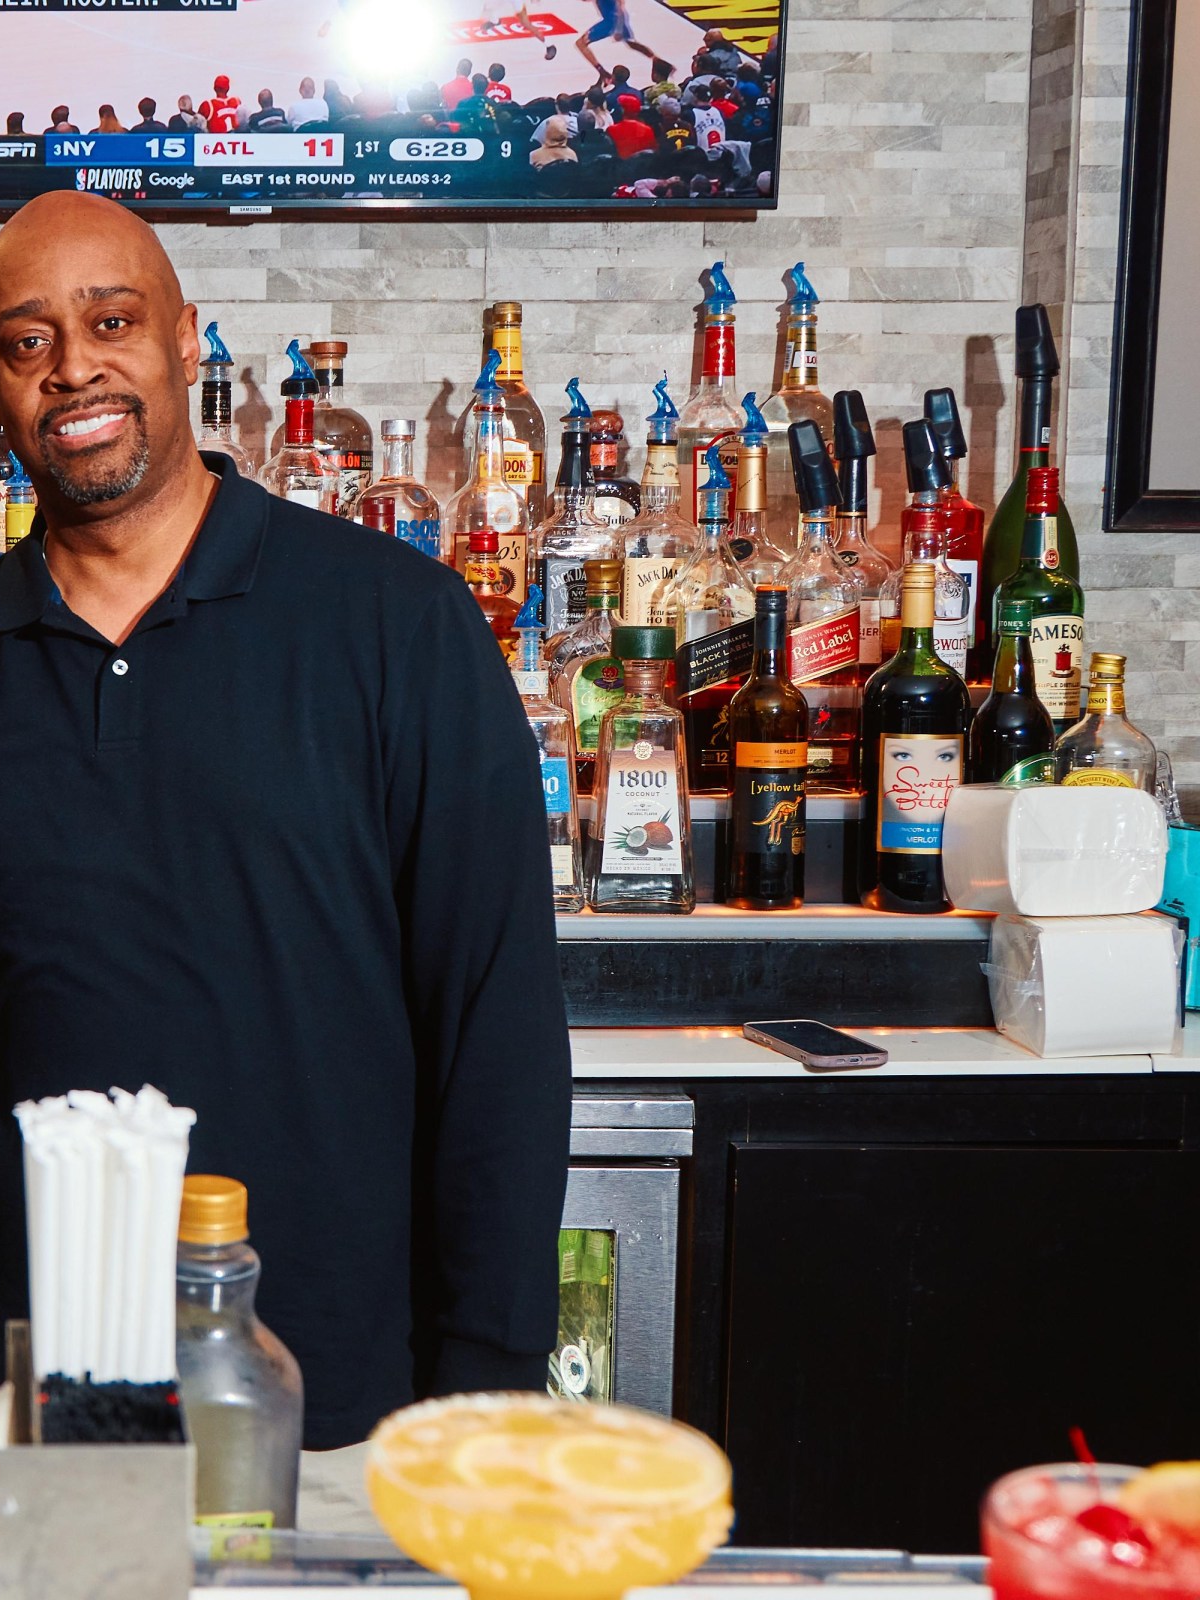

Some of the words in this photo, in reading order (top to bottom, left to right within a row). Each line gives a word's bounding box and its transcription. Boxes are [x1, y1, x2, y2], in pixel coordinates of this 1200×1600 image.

[145, 138, 186, 158] 15
[303, 138, 333, 157] 11
[406, 142, 468, 157] 6:28
[500, 141, 512, 158] 9
[87, 169, 143, 190] PLAYOFFS
[149, 173, 195, 188] Google
[222, 174, 262, 185] EAST
[268, 174, 290, 185] 1st
[296, 174, 355, 185] ROUND
[368, 174, 384, 185] NY
[389, 174, 429, 185] LEADS
[432, 174, 451, 185] 3-2
[550, 570, 574, 589] JACK
[575, 566, 587, 581] DA
[637, 569, 661, 588] JACK
[1031, 624, 1083, 643] AMESO
[792, 642, 819, 660] Red
[820, 629, 854, 651] Label
[689, 651, 721, 669] BLACK
[723, 641, 753, 656] LABEL
[716, 752, 728, 763] 12
[774, 748, 796, 756] MERLOT
[618, 769, 668, 788] 1800
[892, 766, 959, 793] Sweet
[757, 783, 791, 794] yellow
